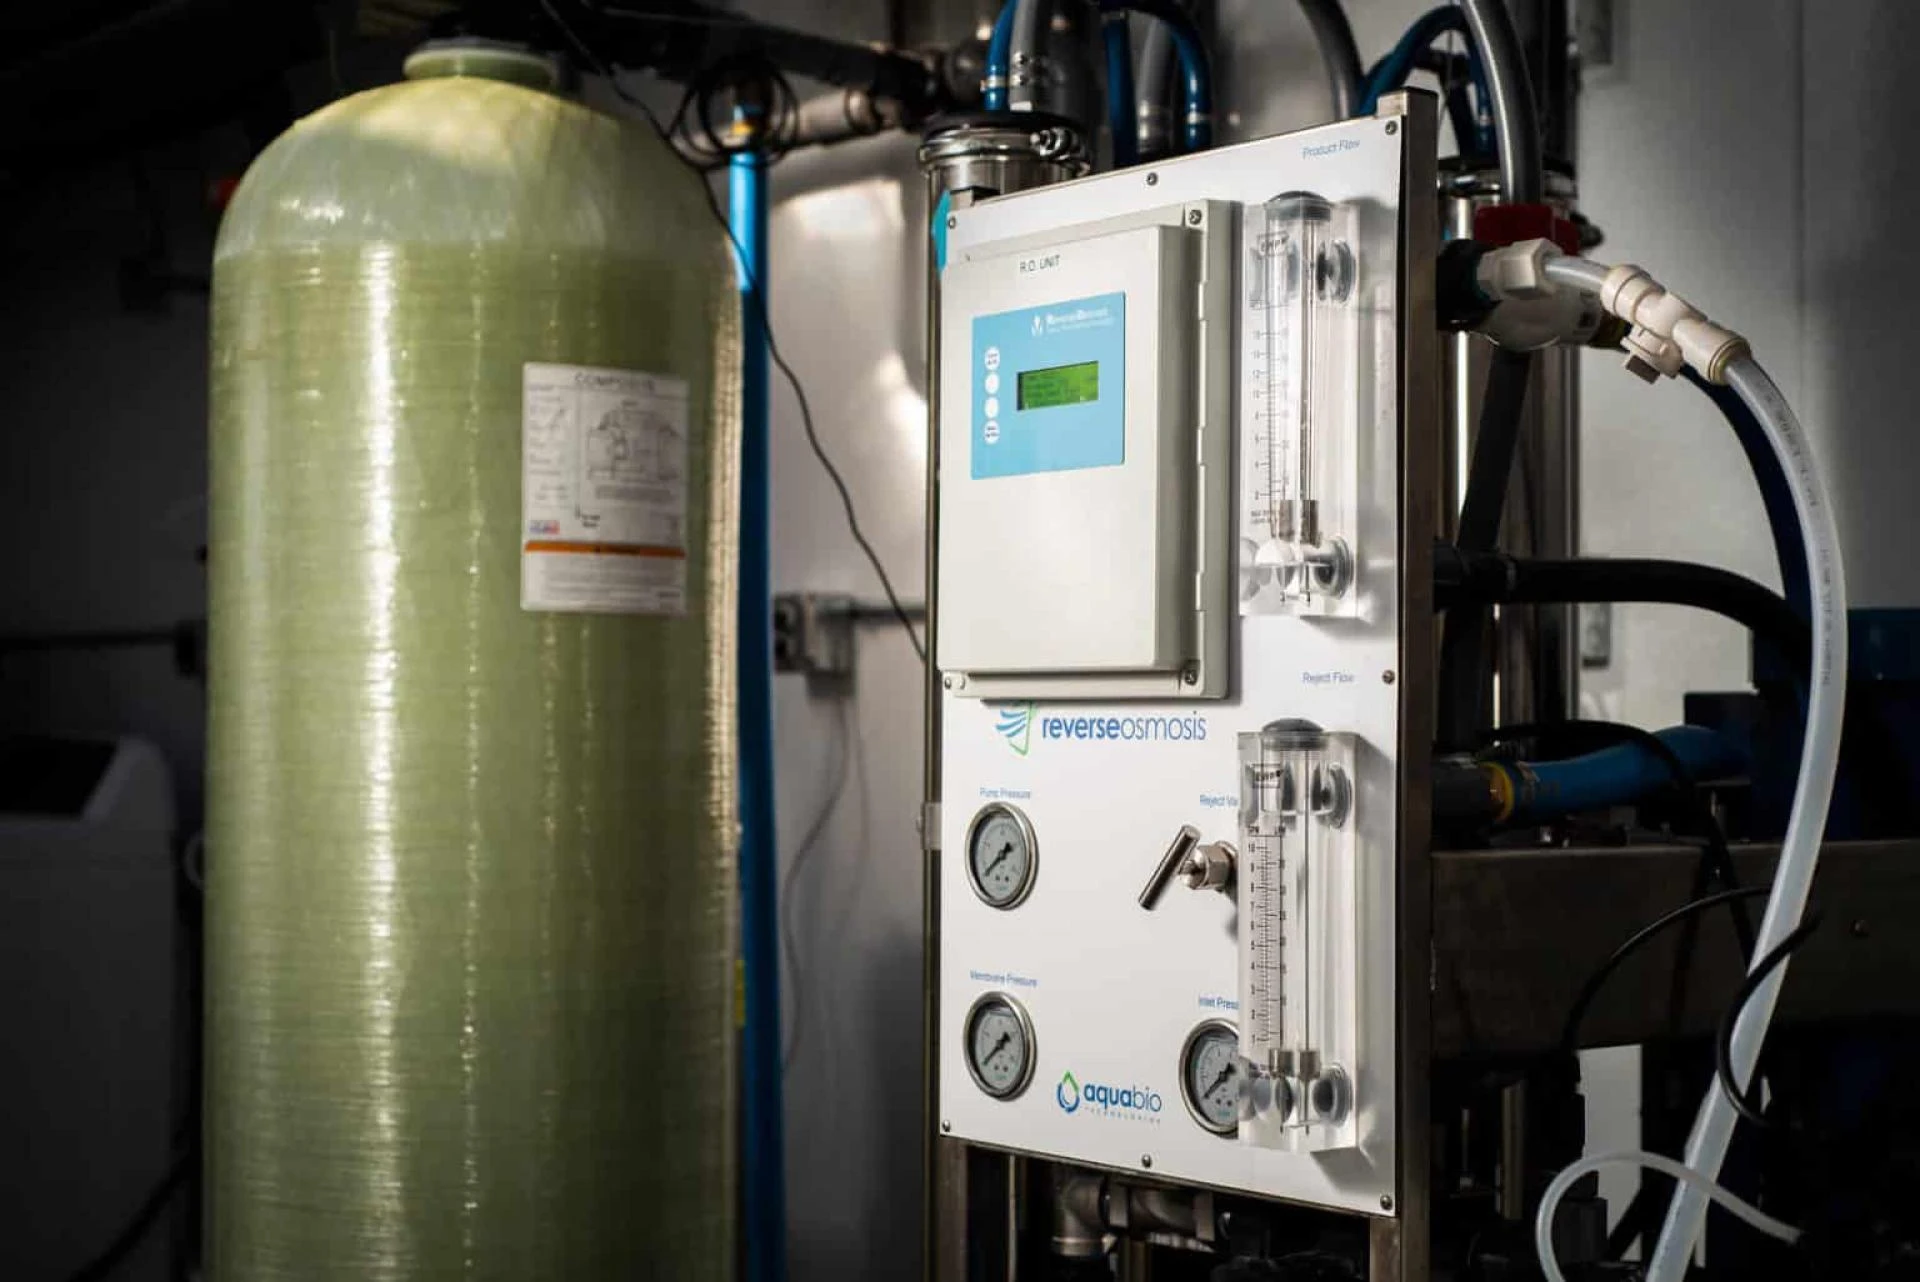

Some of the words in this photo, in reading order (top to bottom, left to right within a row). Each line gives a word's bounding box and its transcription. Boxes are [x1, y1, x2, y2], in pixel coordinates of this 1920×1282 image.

[1302, 144, 1337, 159] Product
[1339, 139, 1360, 150] Flow
[1039, 254, 1060, 269] UNIT
[1303, 671, 1331, 686] Reject
[1333, 671, 1355, 682] Flow
[1042, 710, 1207, 740] reverseosmosis
[1001, 787, 1031, 798] Pressure
[1199, 794, 1226, 808] Reject
[970, 969, 1005, 983] Membrane
[1006, 973, 1037, 988] Pressure
[1199, 996, 1217, 1007] Inlet
[1084, 1084, 1162, 1112] aquabio
